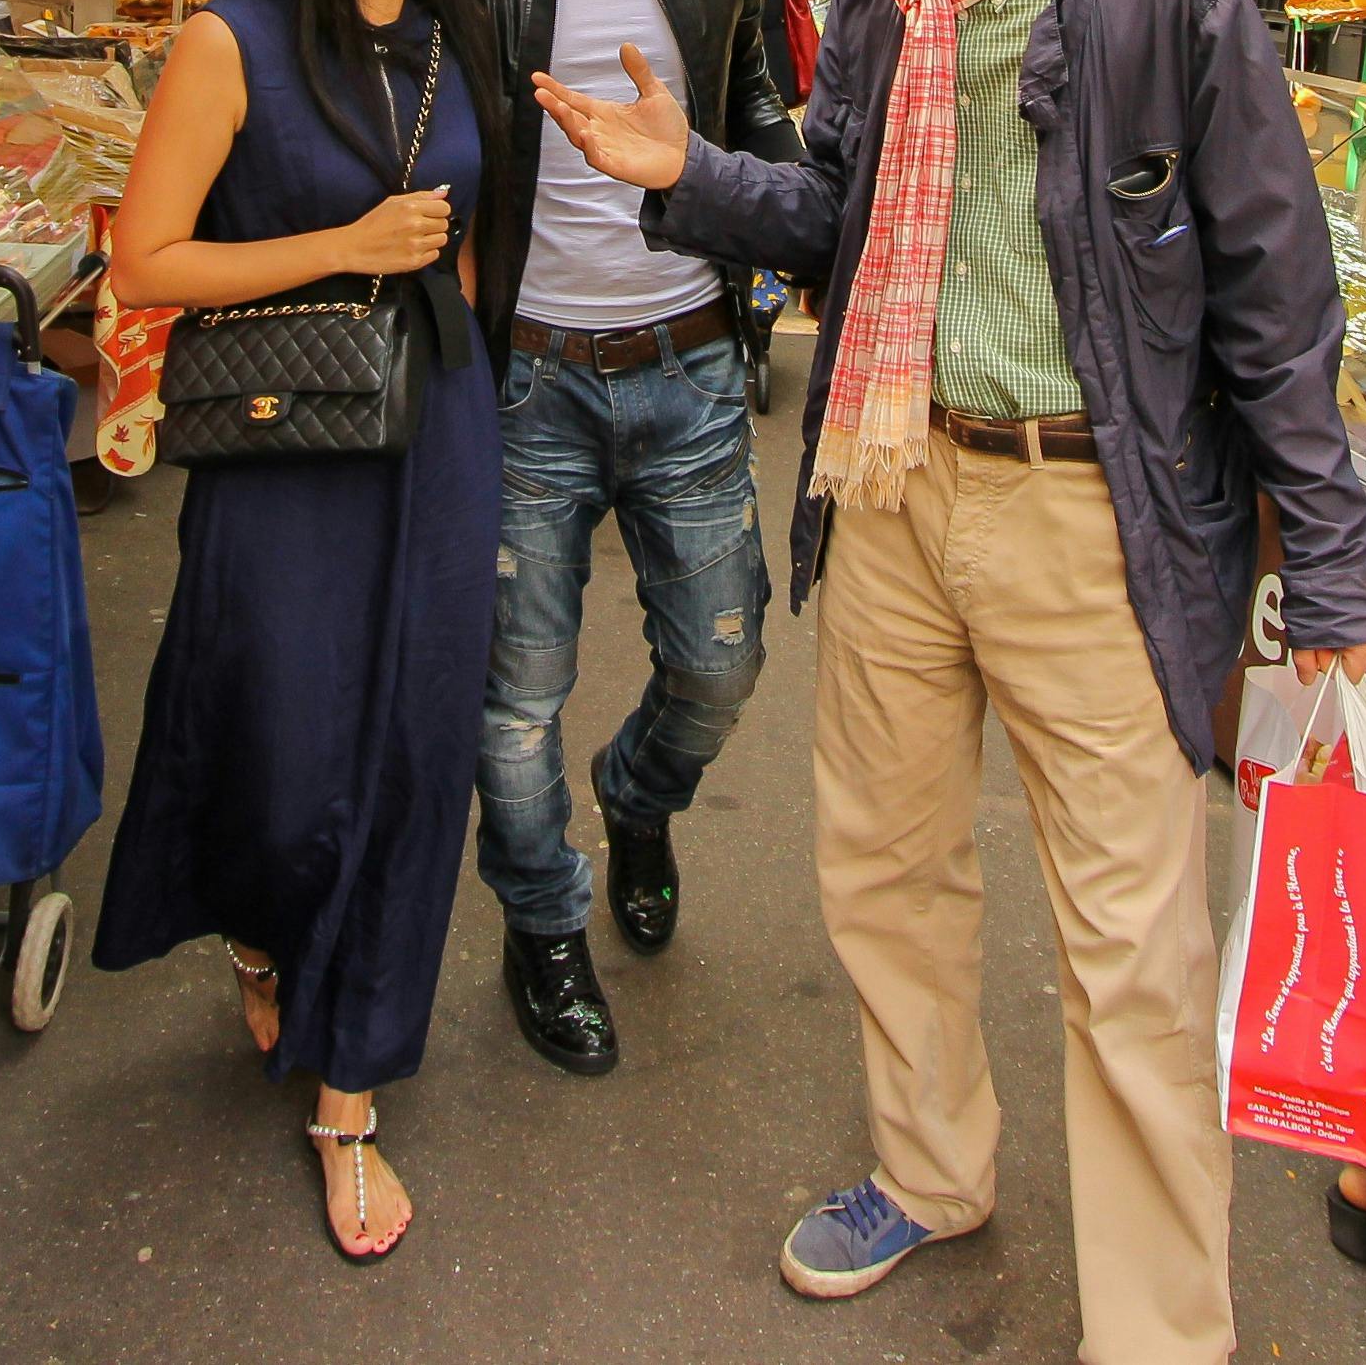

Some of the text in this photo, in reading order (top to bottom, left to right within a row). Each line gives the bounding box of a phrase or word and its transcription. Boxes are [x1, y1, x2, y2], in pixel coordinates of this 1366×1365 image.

[1334, 867, 1347, 899] Terre
[1292, 901, 1304, 911] à
[1339, 900, 1352, 914] la
[1297, 912, 1310, 932] pas
[1342, 914, 1354, 924] à
[1345, 924, 1362, 981] appartient
[1343, 977, 1356, 1000] qui
[1265, 994, 1286, 1024] Terre
[1281, 1102, 1321, 1118] ARGAUD
[1286, 1112, 1312, 1125] Fruits
[1313, 1117, 1324, 1127] de
